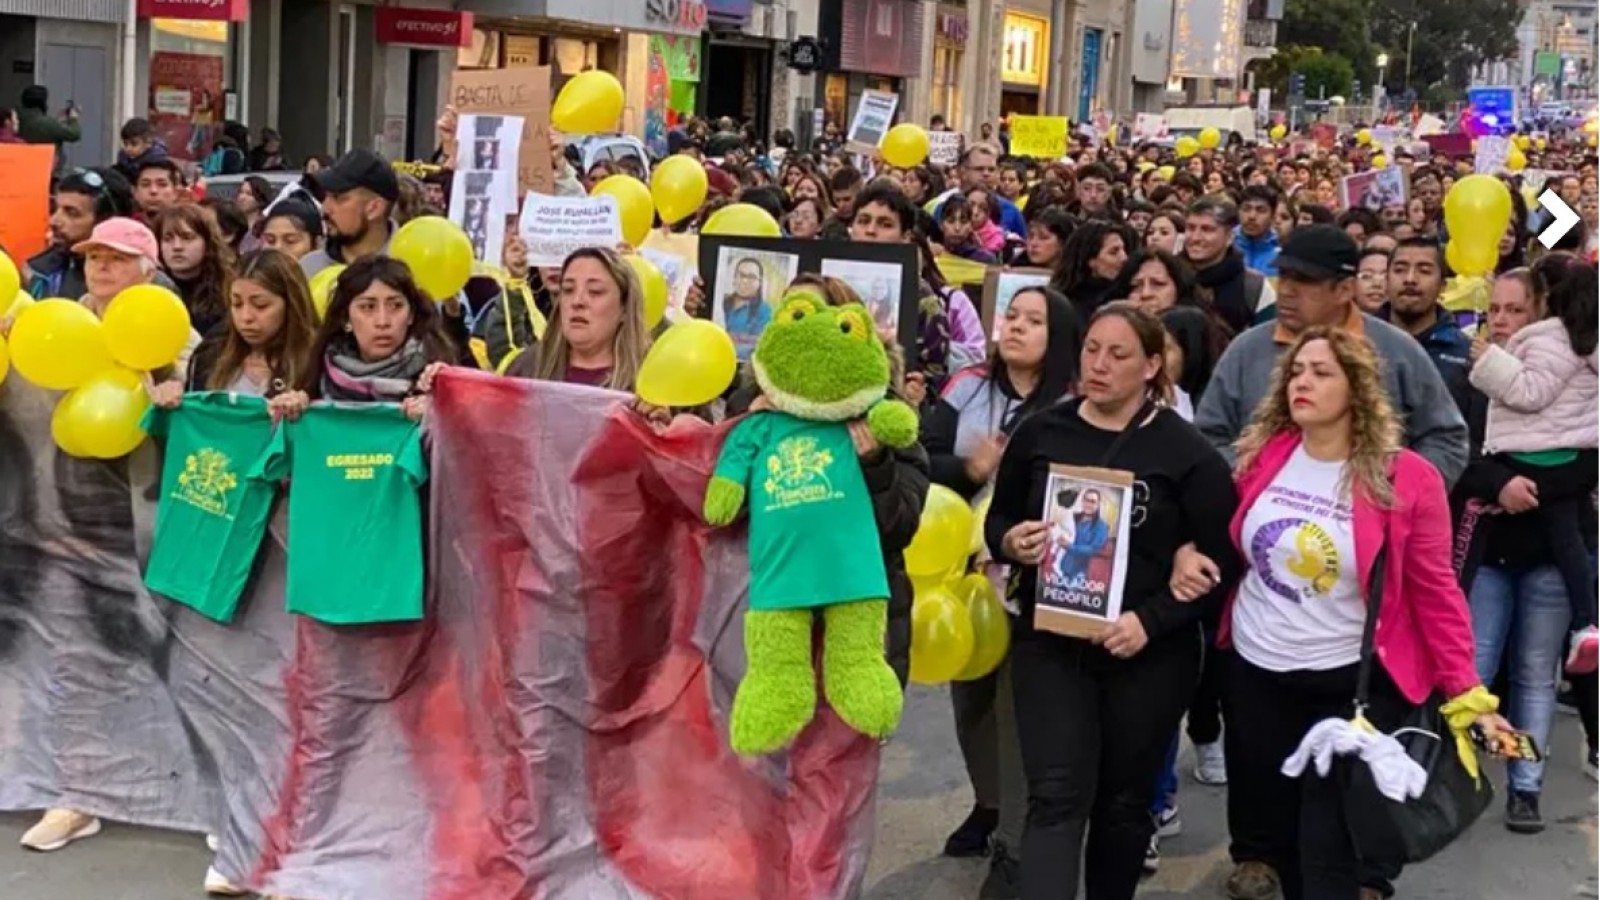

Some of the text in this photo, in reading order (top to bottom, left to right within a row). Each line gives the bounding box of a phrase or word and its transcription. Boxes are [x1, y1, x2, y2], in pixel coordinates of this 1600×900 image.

[455, 84, 503, 107] BASTA
[326, 453, 394, 467] EGRESADO
[345, 467, 374, 480] 2022
[1044, 572, 1105, 592] VIOLADOR
